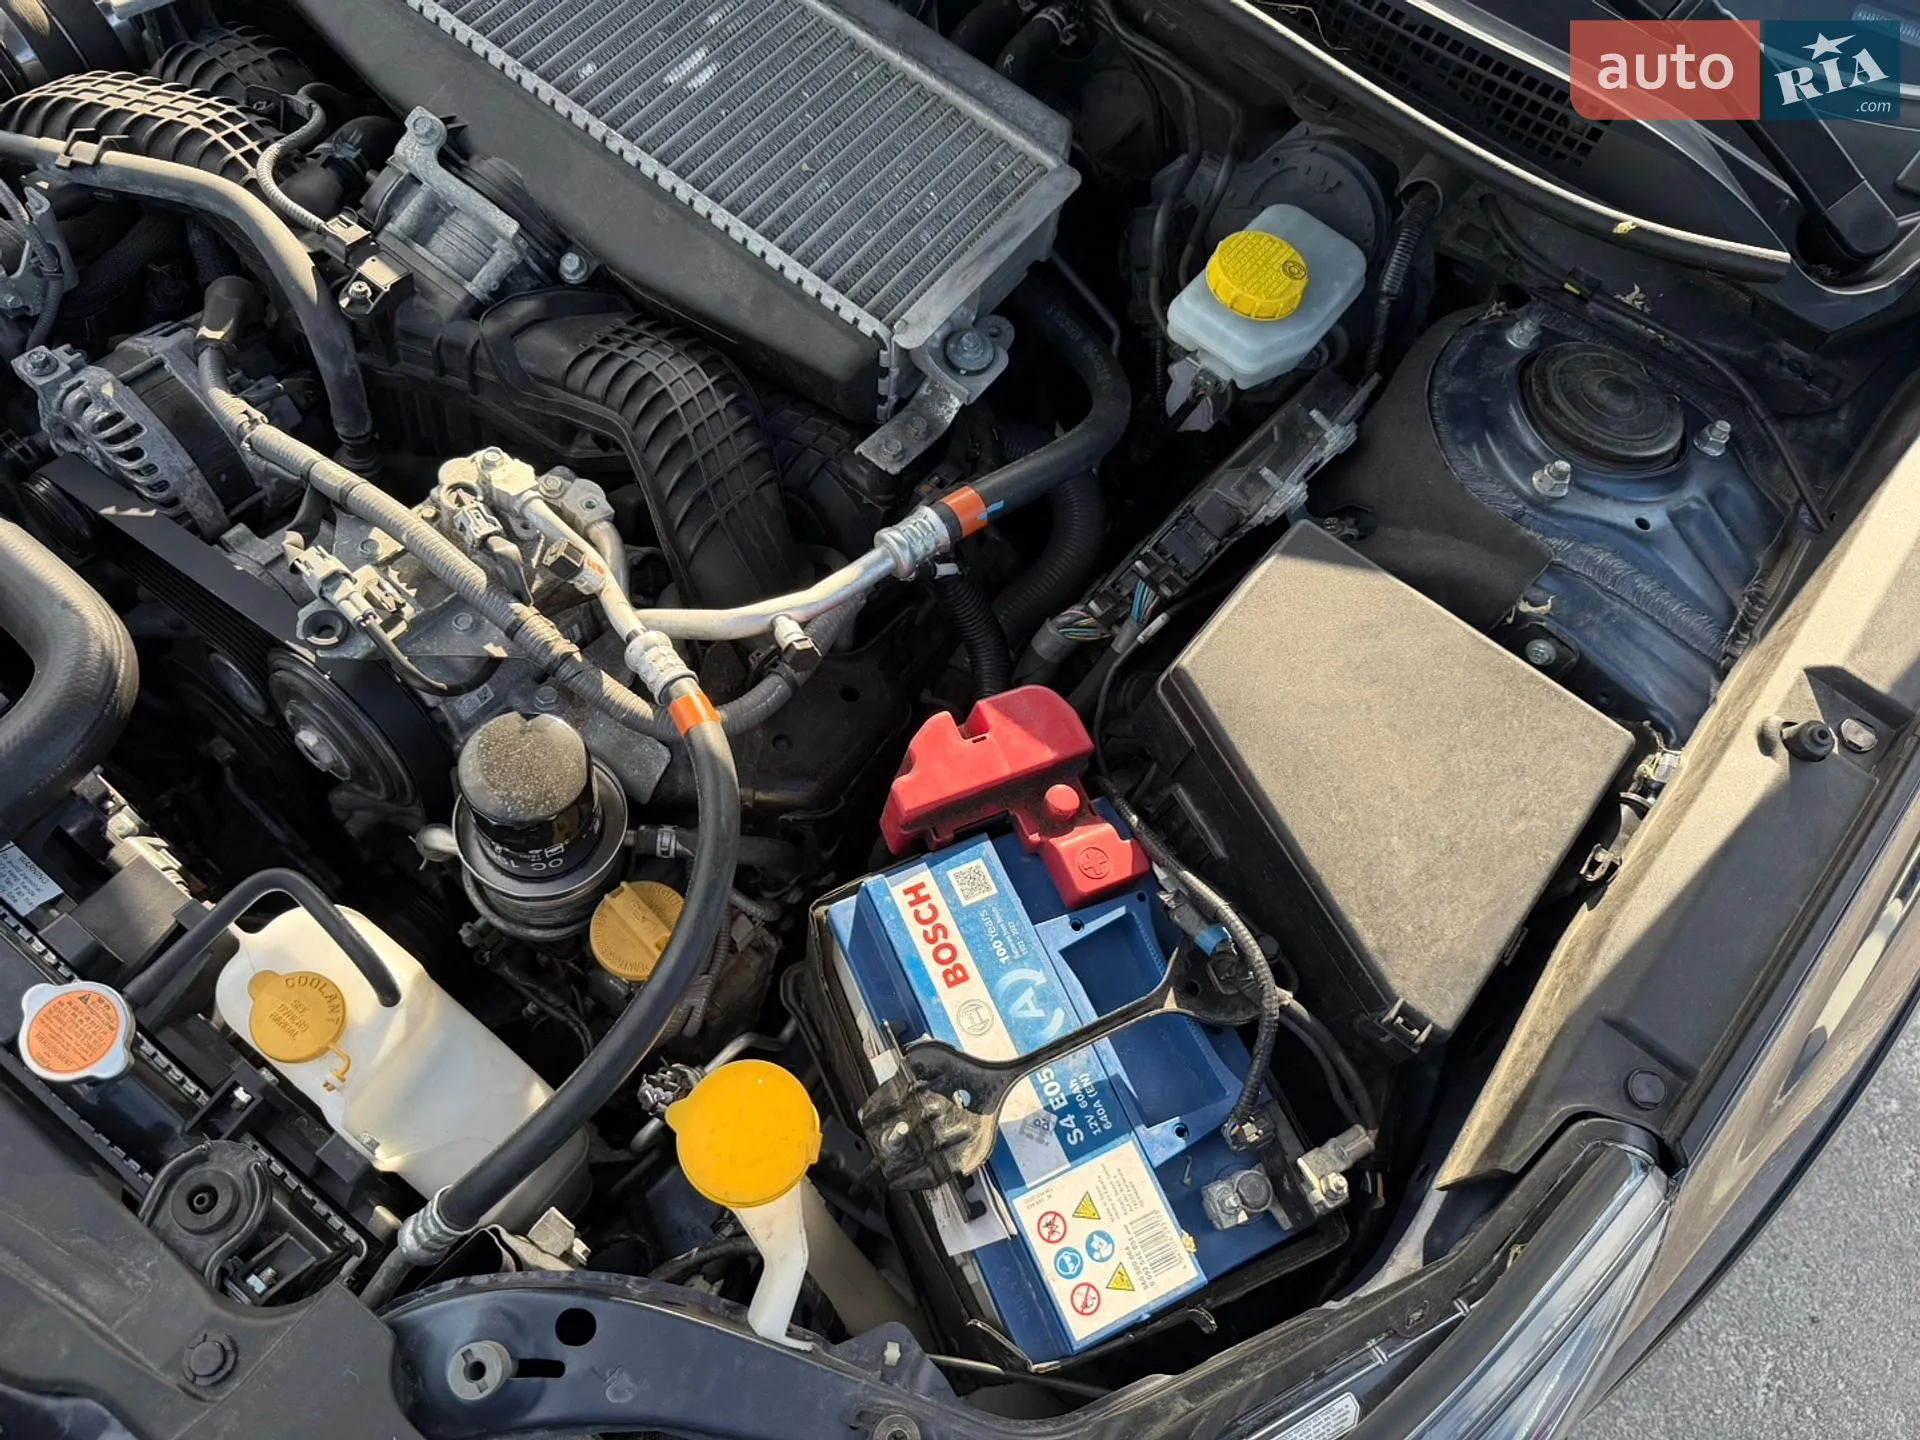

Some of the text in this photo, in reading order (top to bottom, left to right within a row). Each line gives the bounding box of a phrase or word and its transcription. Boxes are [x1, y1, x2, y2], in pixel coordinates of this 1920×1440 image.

[17, 854, 49, 885] WARNING
[530, 857, 563, 871] OC
[901, 879, 970, 990] BOSCH
[977, 908, 1010, 965] 100 Years
[284, 976, 341, 1026] COOLANT
[1035, 1065, 1086, 1147] S4 E05
[1067, 1077, 1102, 1136] 12V 60Ah
[1078, 1071, 1113, 1130] 640A (EN)
